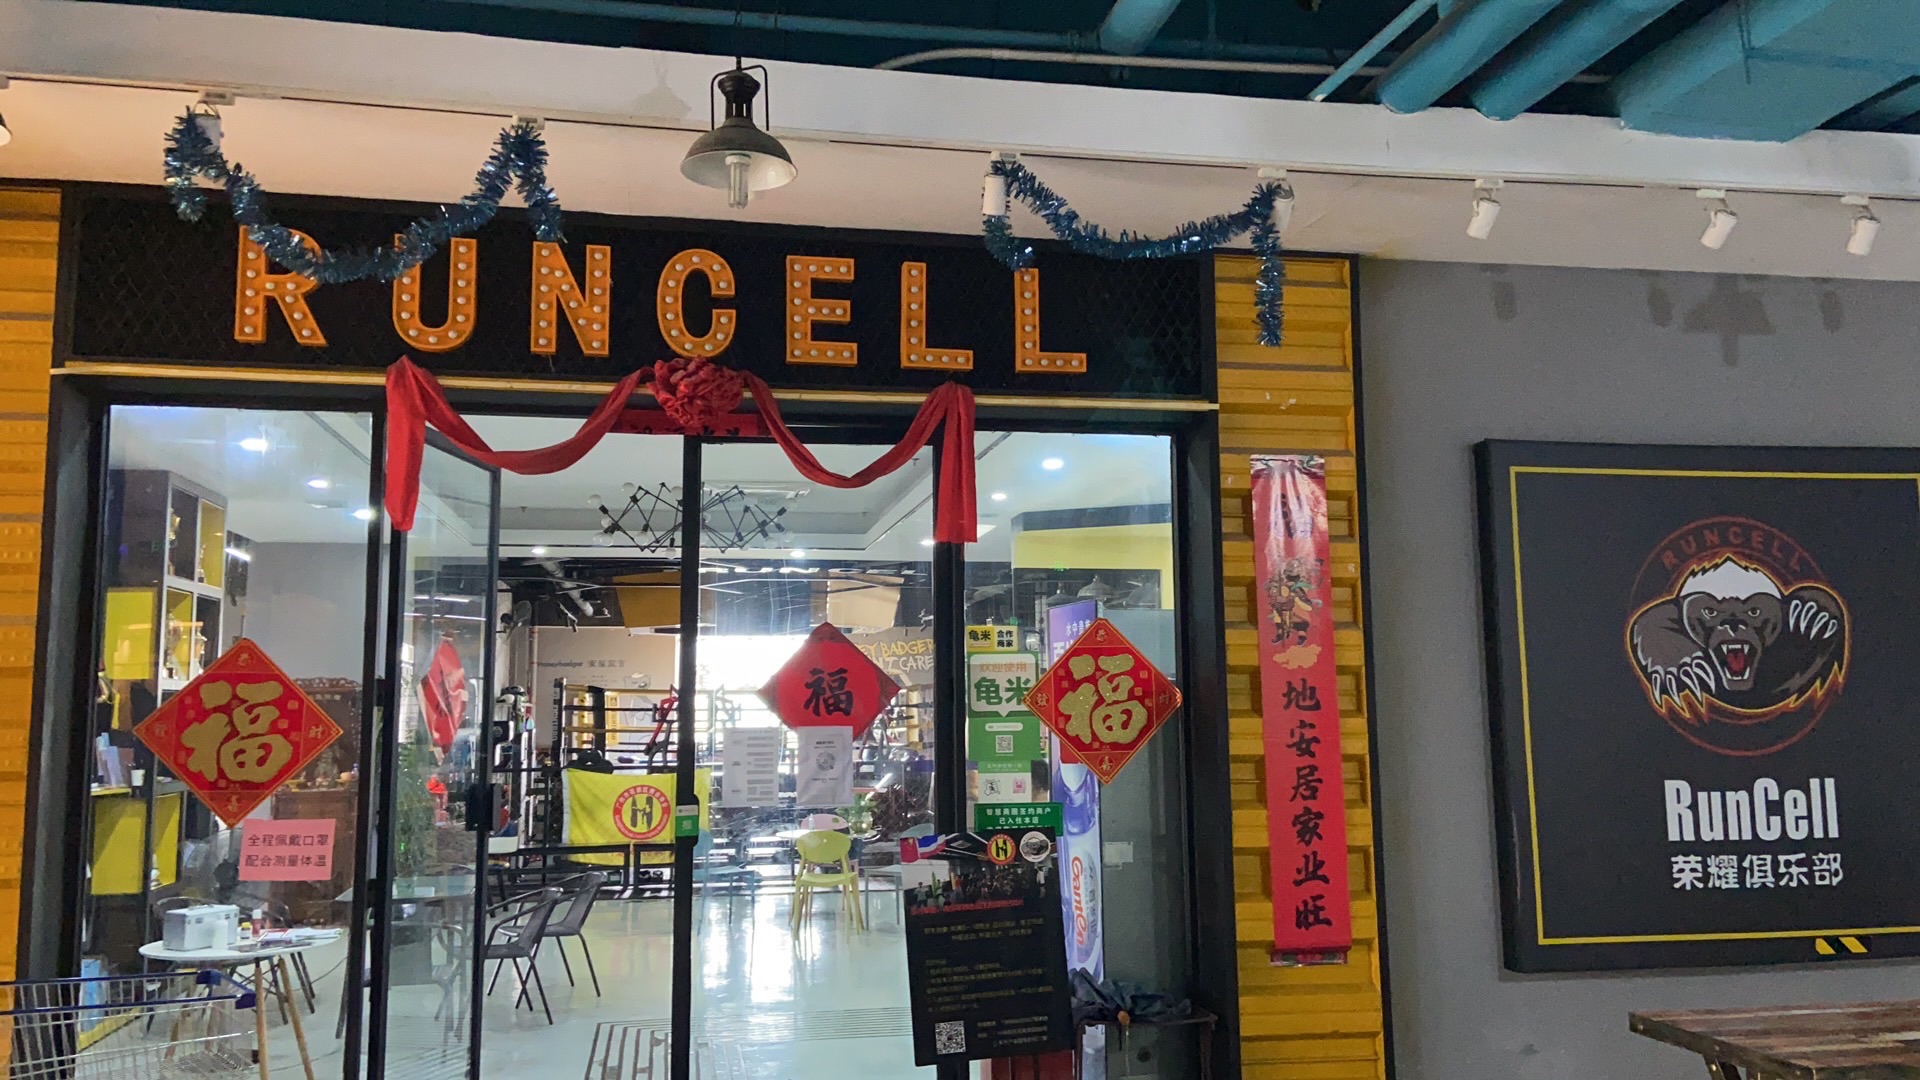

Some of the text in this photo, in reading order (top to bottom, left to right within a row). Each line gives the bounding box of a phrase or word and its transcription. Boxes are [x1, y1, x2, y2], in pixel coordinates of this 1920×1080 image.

[234, 225, 1087, 374] RUNCELL
[1662, 526, 1801, 572] RUNCELL
[997, 630, 1013, 638] 合作
[899, 655, 934, 673] CARE
[981, 663, 1027, 673] 欢迎使用
[803, 669, 855, 717] 福
[1057, 653, 1148, 744] 福
[180, 680, 294, 783] 福
[1664, 777, 1840, 841] RunCell
[245, 854, 327, 867] 配合测量体温
[247, 834, 329, 847] 全程佩戴口罩
[1670, 852, 1844, 891] 荣耀俱乐部
